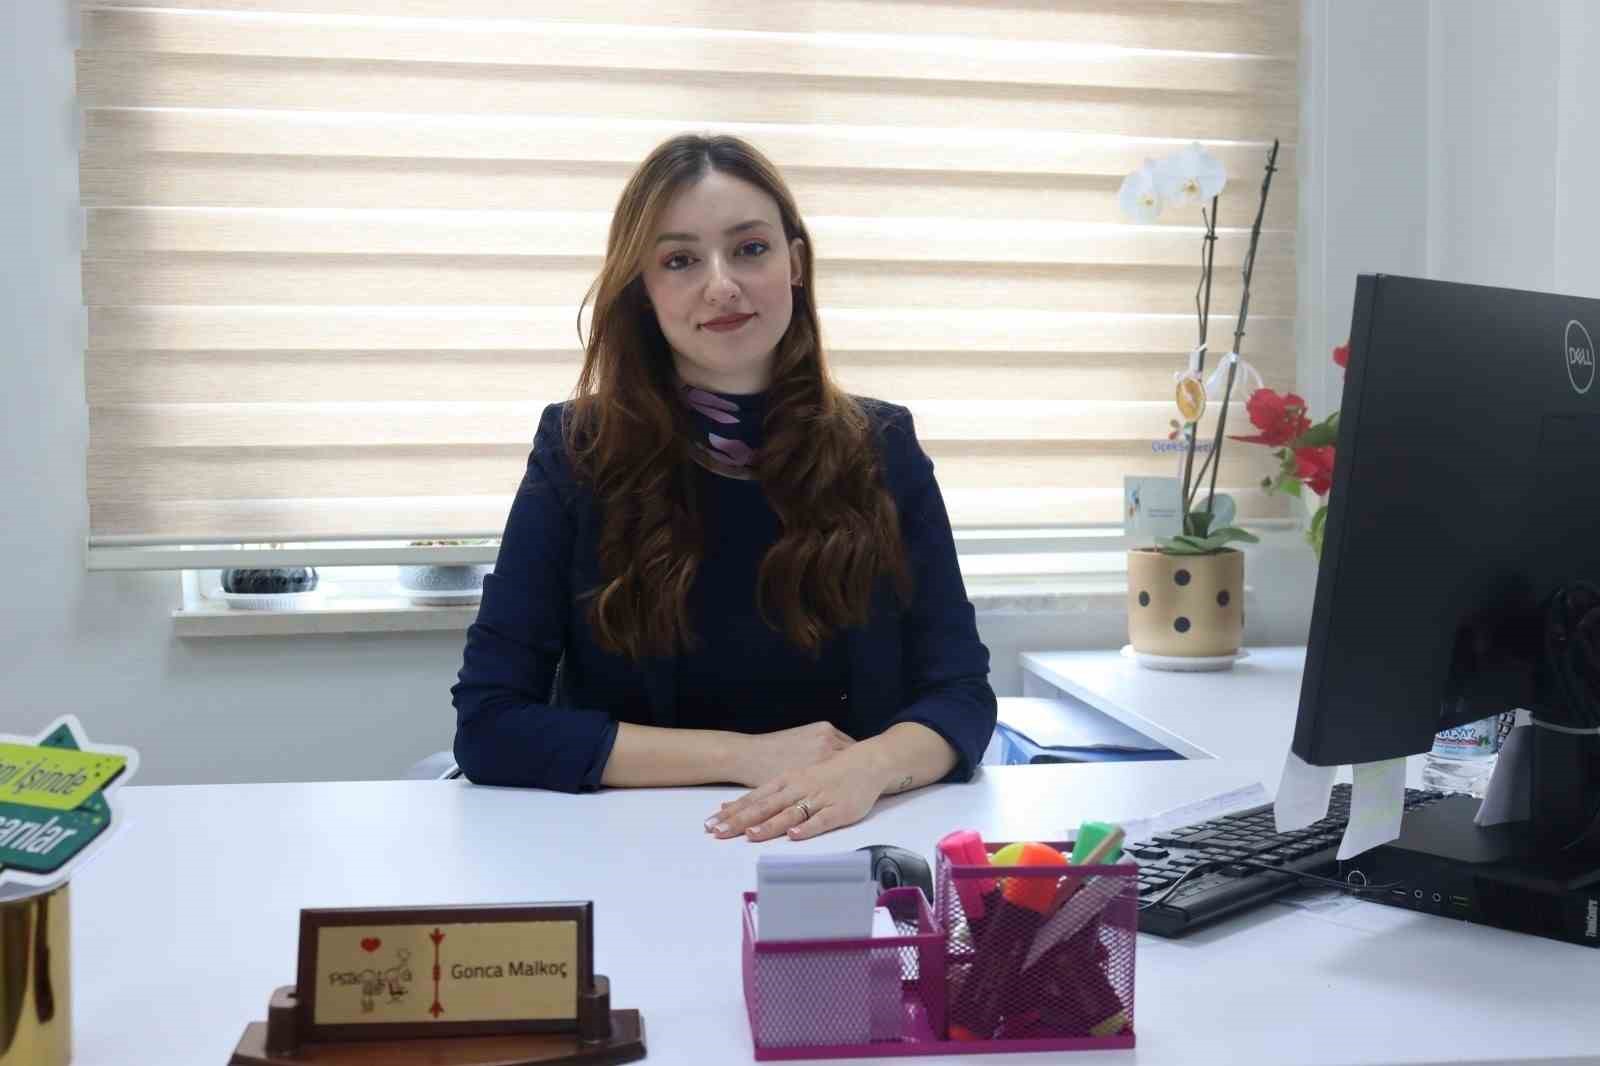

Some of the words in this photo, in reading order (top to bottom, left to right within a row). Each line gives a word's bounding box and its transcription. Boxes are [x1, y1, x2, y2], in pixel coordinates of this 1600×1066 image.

[1568, 346, 1593, 366] DELL
[0, 815, 78, 855] anlar
[451, 963, 504, 981] Gonca
[508, 959, 568, 980] Malkoç
